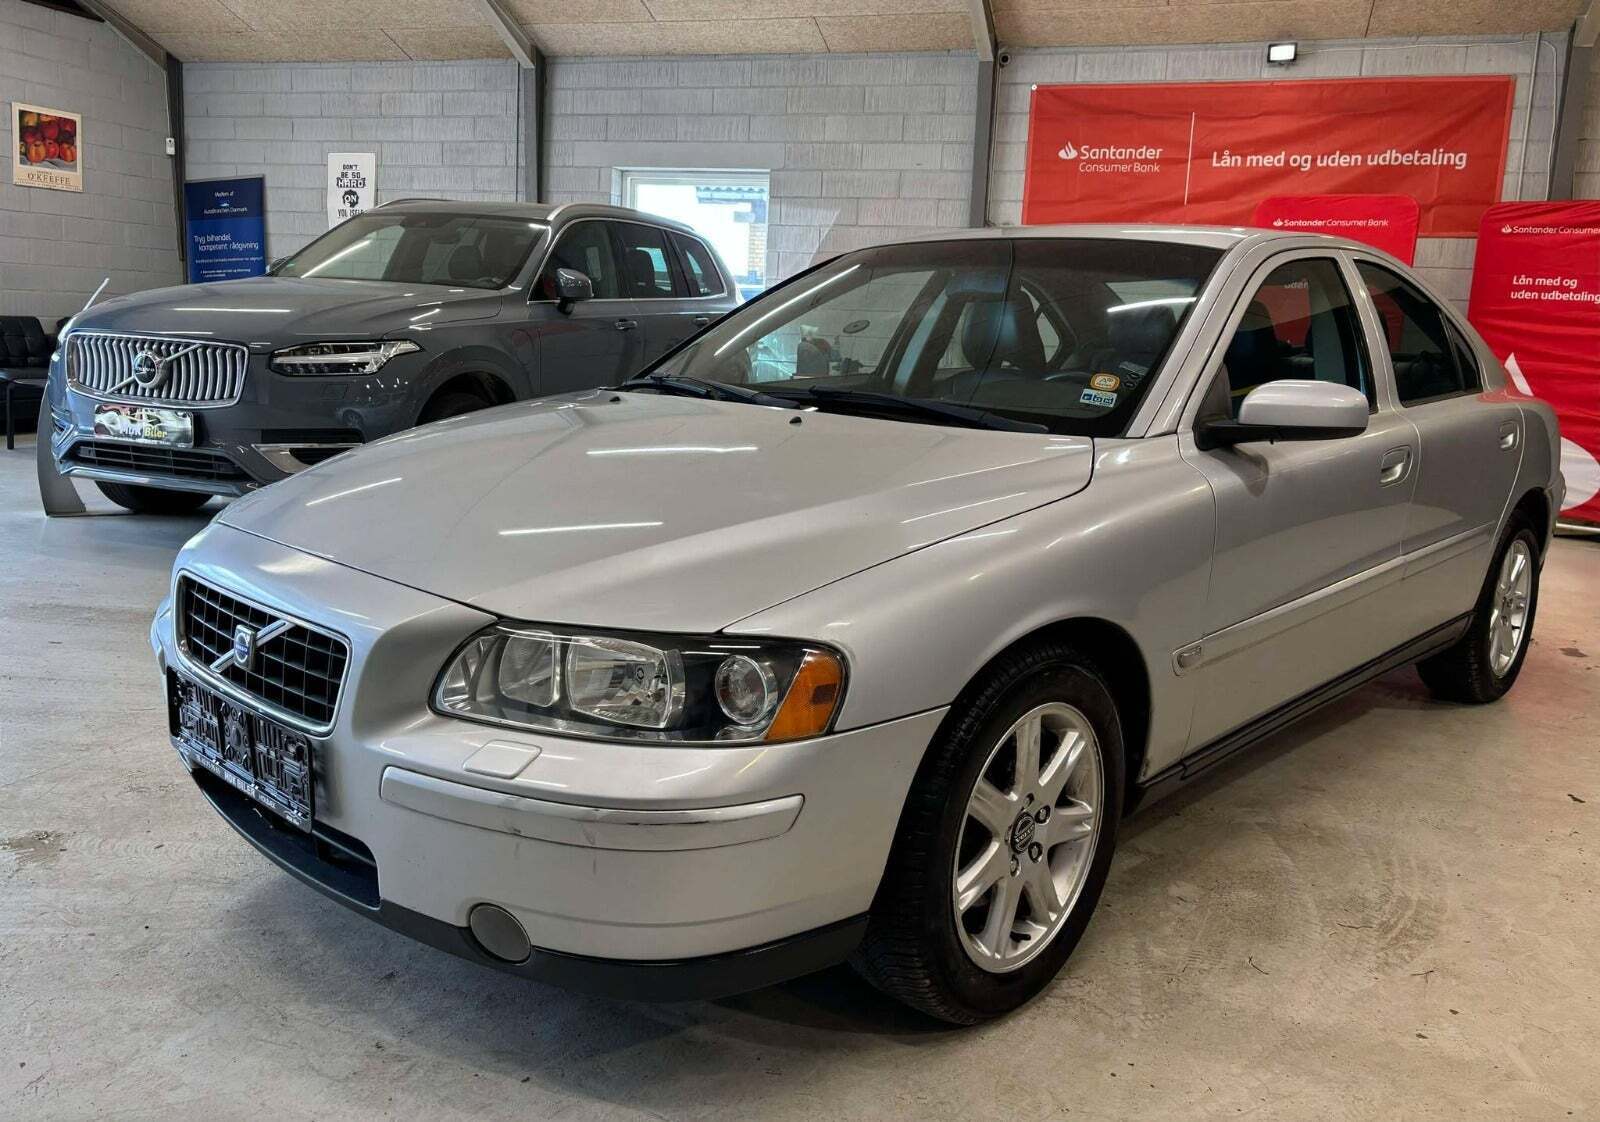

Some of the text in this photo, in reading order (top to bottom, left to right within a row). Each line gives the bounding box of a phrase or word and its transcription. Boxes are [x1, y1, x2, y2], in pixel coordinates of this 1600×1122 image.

[1080, 145, 1163, 159] Santander
[1212, 148, 1468, 171] Lån med og uden udbetaling
[1079, 162, 1161, 173] Consumer Bank
[27, 171, 71, 185] O'KEEFFE
[338, 178, 364, 188] HARD
[1284, 219, 1389, 227] Santander Consumer Bank
[1513, 225, 1557, 234] Santander
[1512, 274, 1578, 289] Lån med og
[1510, 289, 1600, 304] uden udbetaling
[144, 427, 168, 438] Biler
